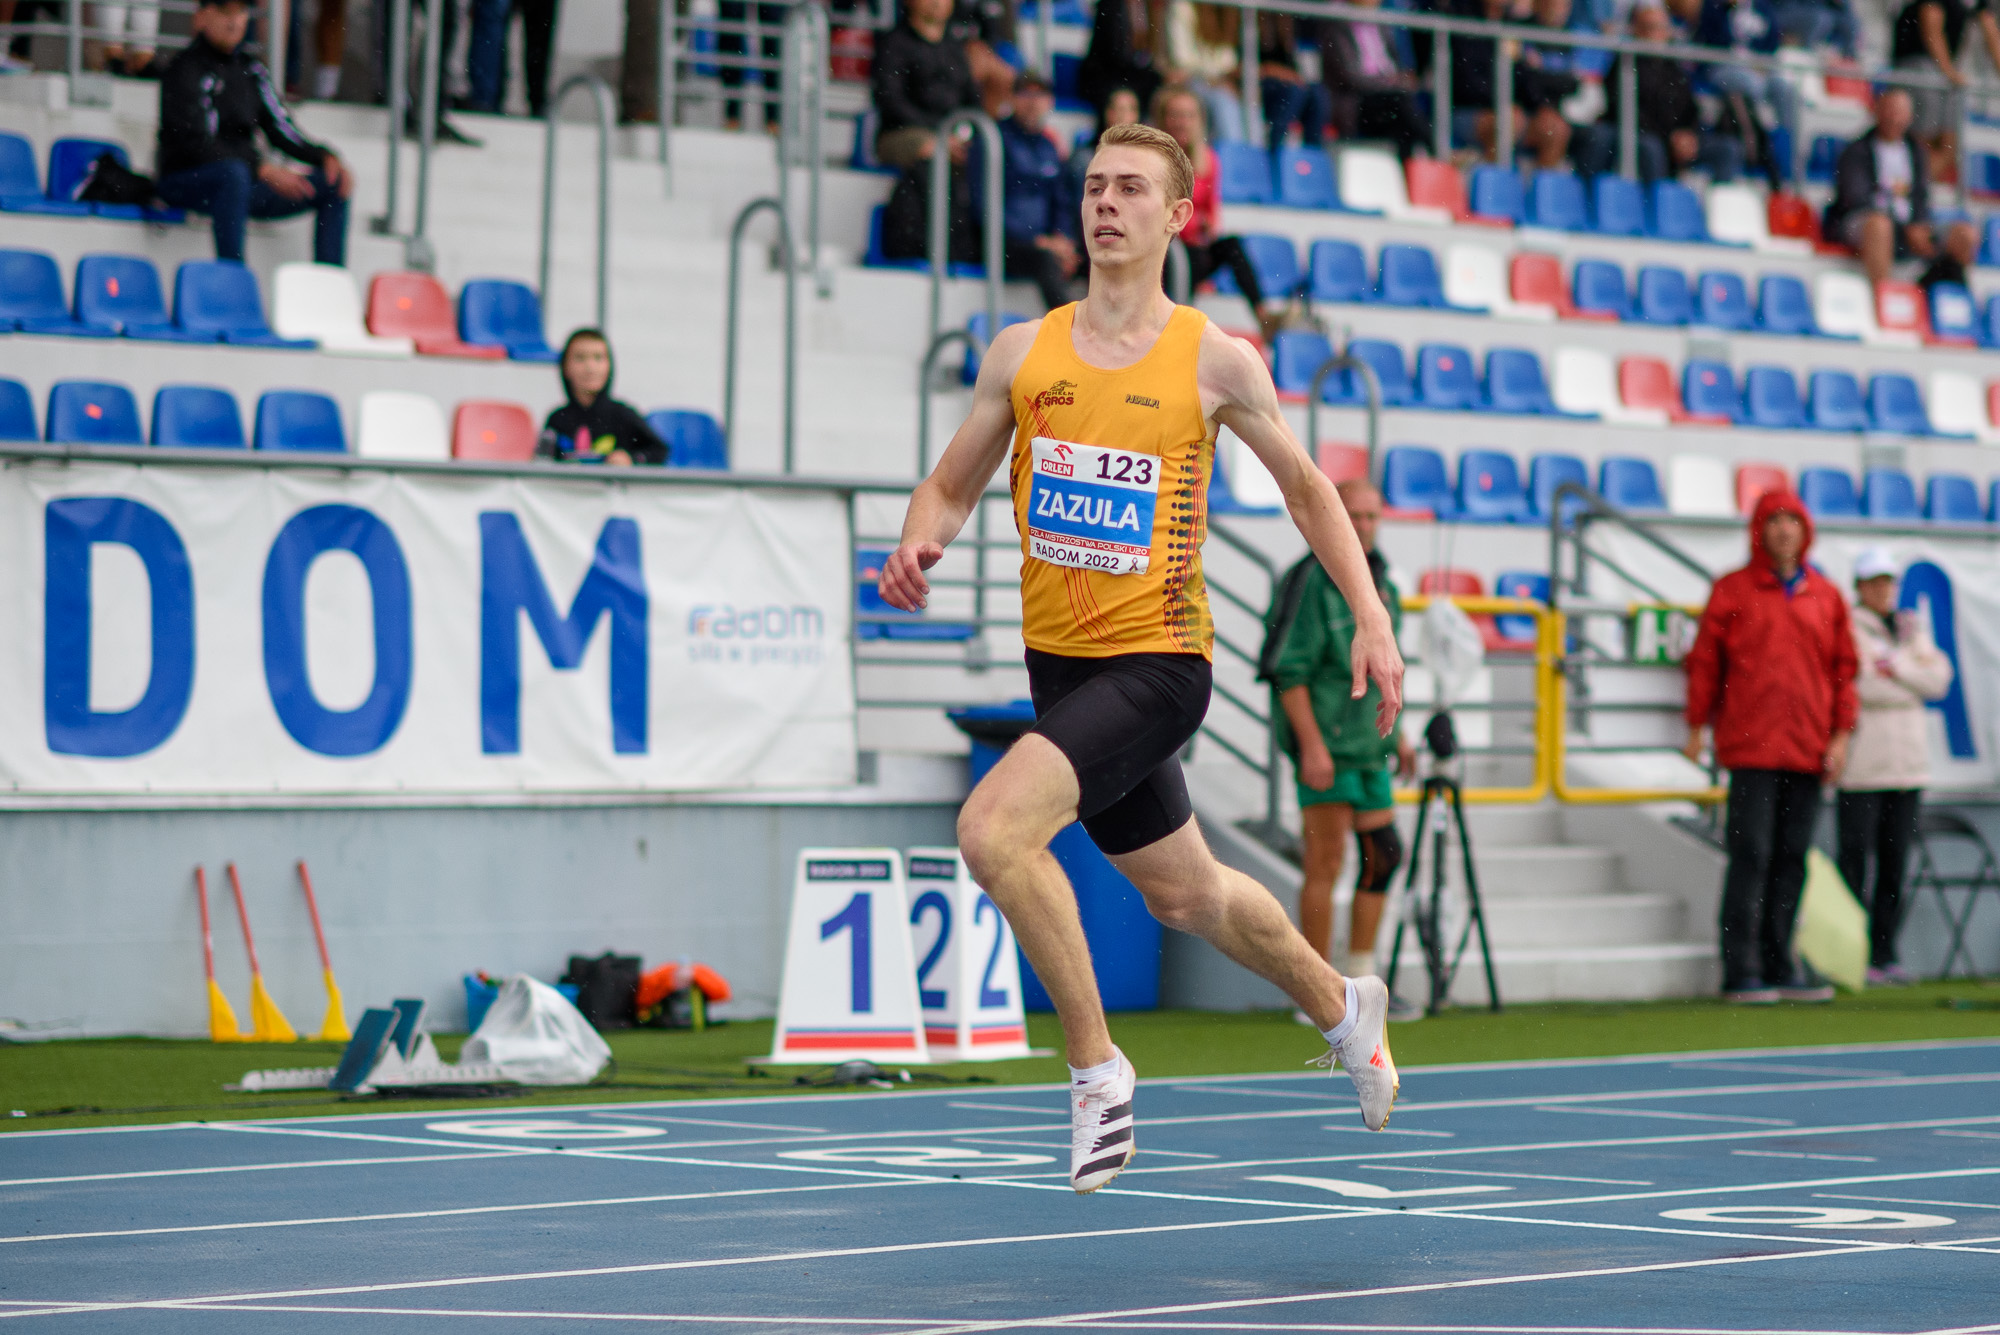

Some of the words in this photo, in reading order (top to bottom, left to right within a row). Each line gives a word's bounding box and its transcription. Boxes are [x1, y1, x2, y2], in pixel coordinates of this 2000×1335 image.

[1042, 461, 1072, 474] ORLEN
[1096, 453, 1153, 485] 123
[1036, 488, 1140, 531] ZAZULA
[1030, 529, 1045, 538] PZLA
[1045, 532, 1096, 548] MISTRZOSTWA
[1097, 542, 1127, 553] POLSKI
[1129, 547, 1148, 556] U20
[1036, 542, 1080, 563] RADOM
[1084, 553, 1119, 569] 2022
[820, 891, 872, 1013] 1
[910, 890, 952, 1009] 2
[974, 892, 1009, 1009] 2
